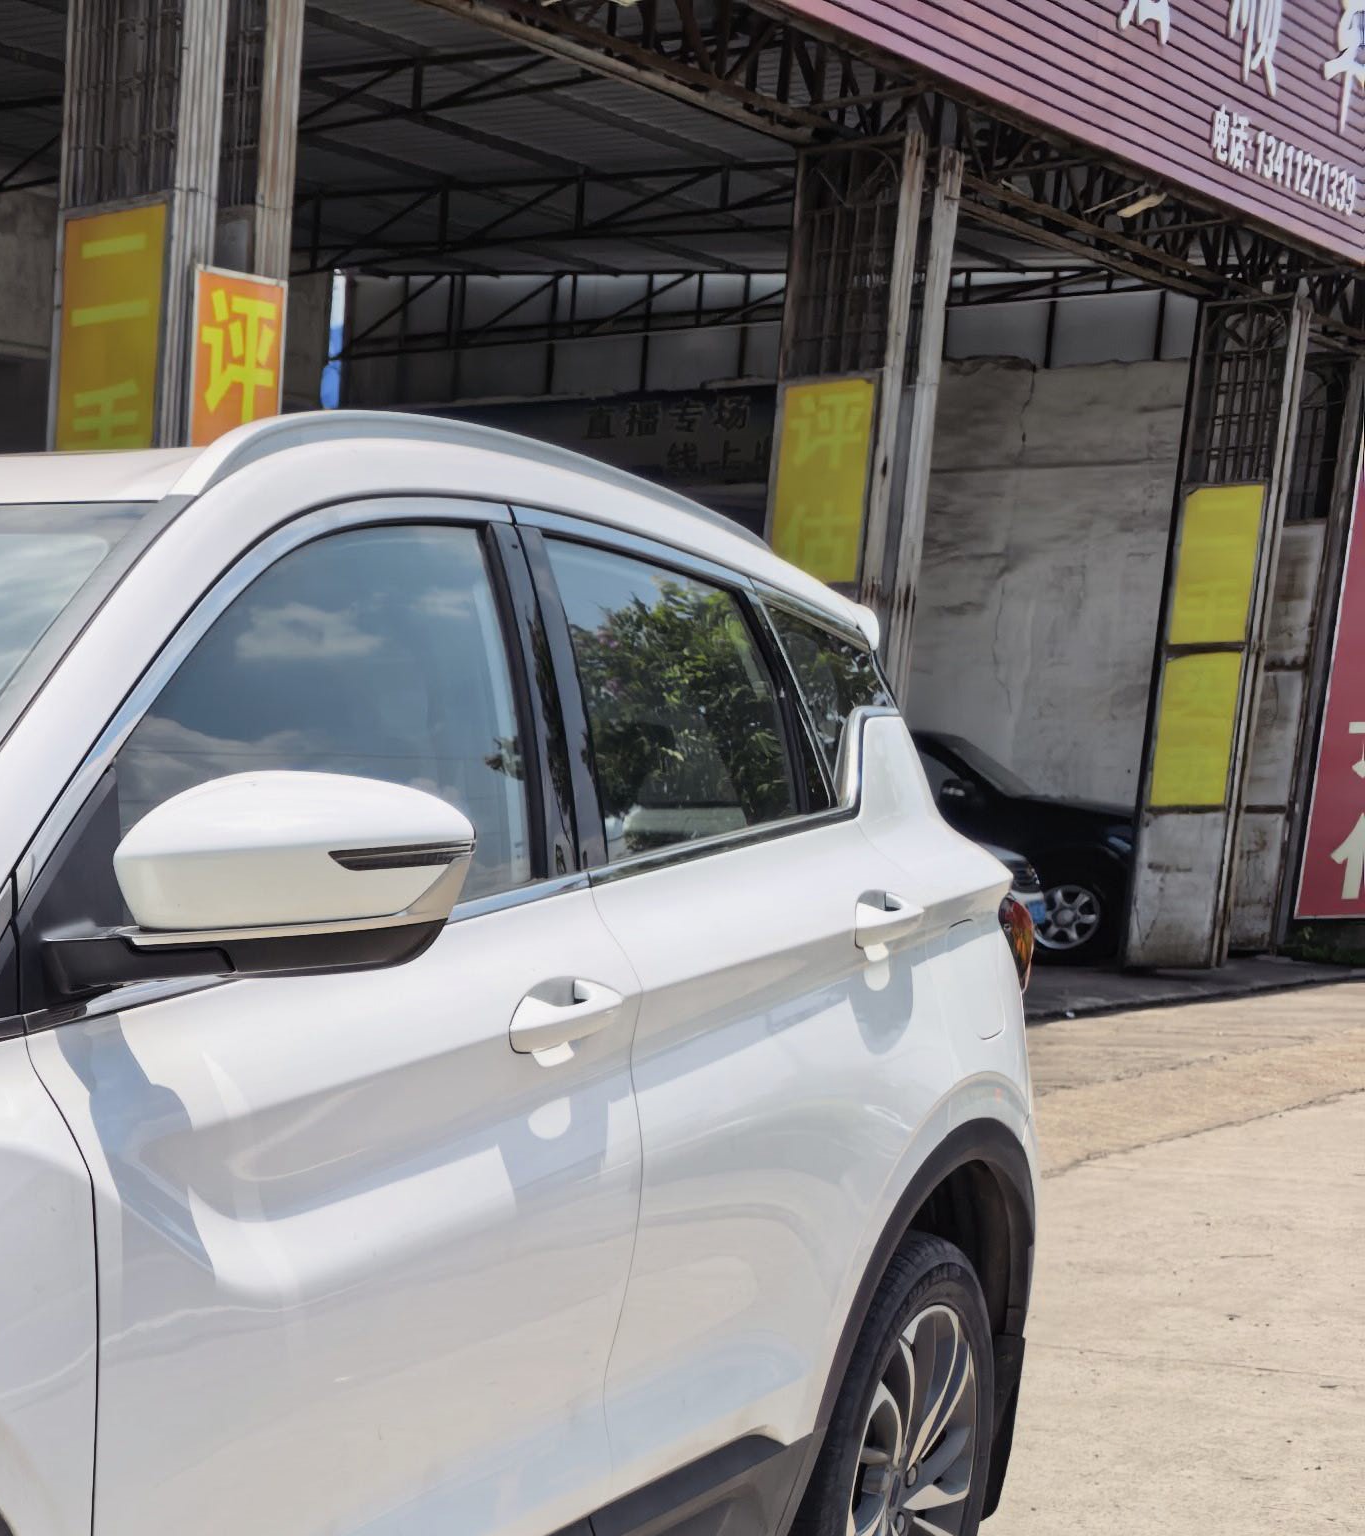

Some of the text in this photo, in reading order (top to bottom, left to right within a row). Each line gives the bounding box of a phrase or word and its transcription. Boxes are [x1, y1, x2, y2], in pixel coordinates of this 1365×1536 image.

[582, 395, 752, 440] 直播专场
[785, 391, 866, 578] 评估
